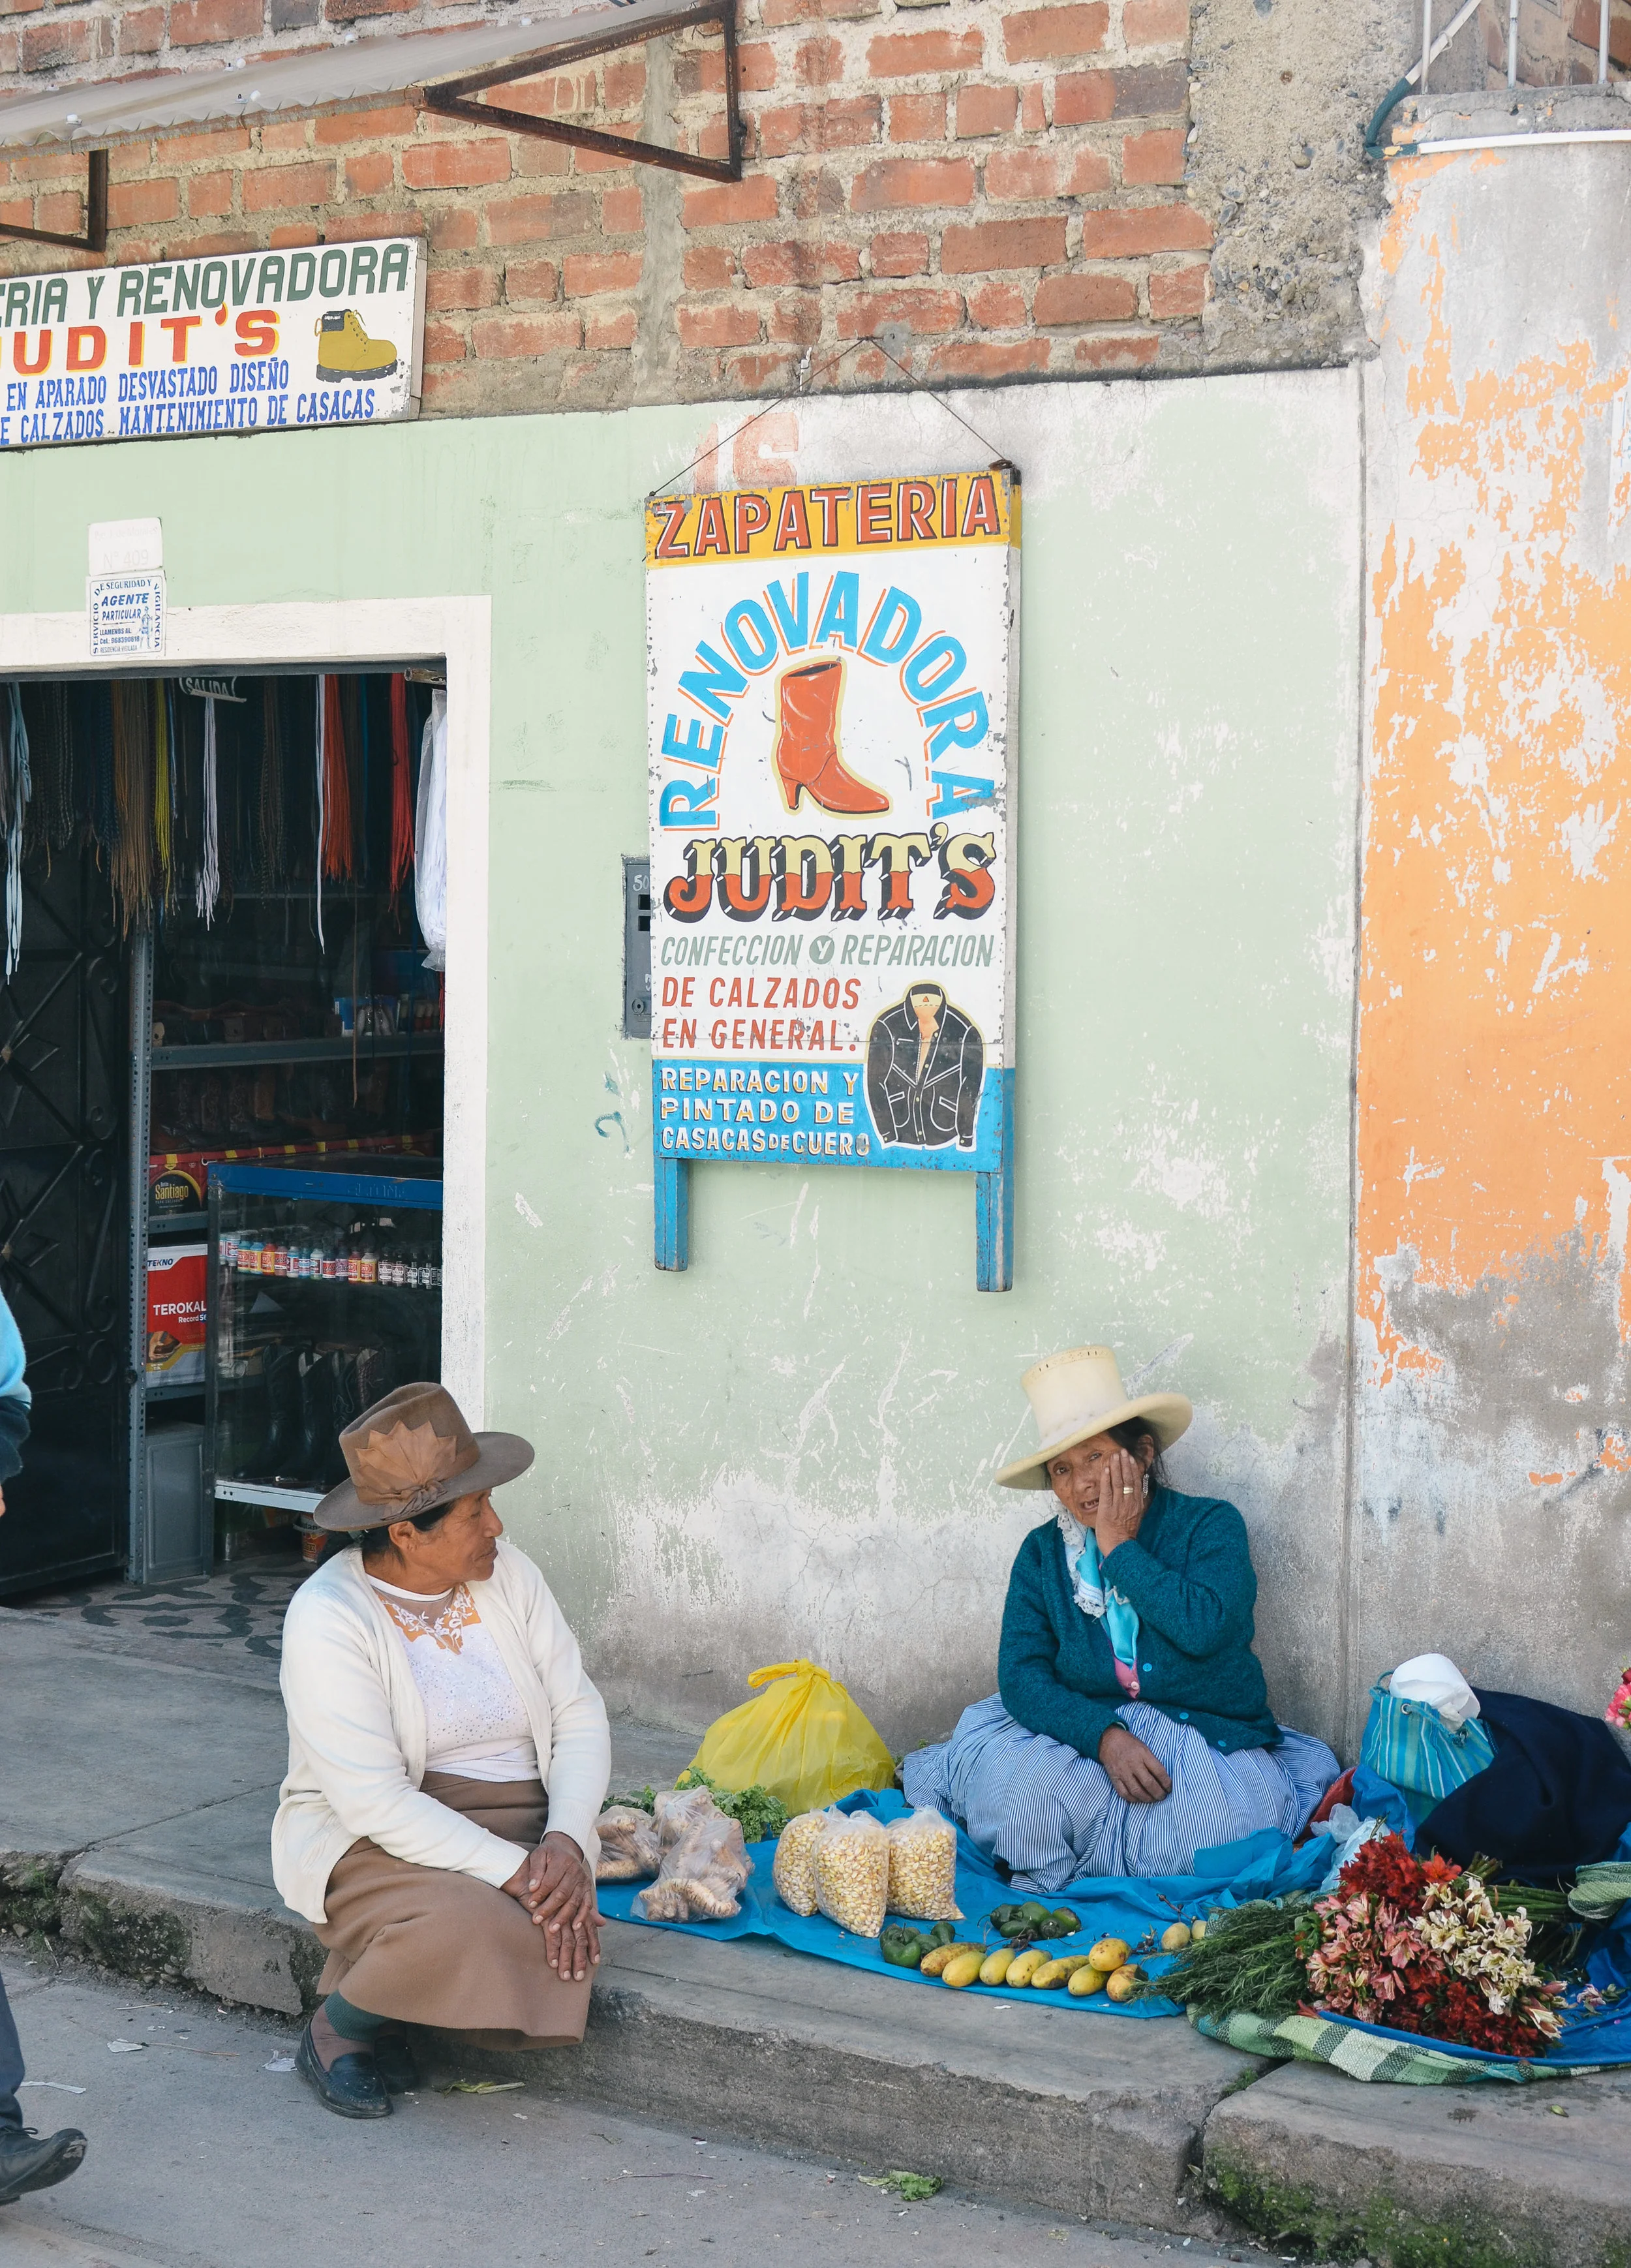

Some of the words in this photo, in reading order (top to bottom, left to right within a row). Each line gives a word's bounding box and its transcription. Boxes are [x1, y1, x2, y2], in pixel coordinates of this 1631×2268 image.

[87, 275, 104, 320] Y
[117, 243, 409, 316] RENOVADORA
[0, 303, 279, 376] UDIT'S
[7, 382, 27, 412] EN
[37, 375, 106, 410] APARADO
[118, 366, 217, 402] DESVASTADO
[230, 356, 288, 393] DISEÑO
[21, 409, 104, 444] CALZADOS
[119, 397, 257, 436] MANTENIMIENTO
[267, 394, 287, 425] DE
[296, 388, 374, 423] CASACAS
[653, 475, 1001, 560] ZAPATERIA
[123, 549, 149, 567] 409
[94, 583, 104, 596] DE
[106, 579, 145, 590] SEGURIDAD
[101, 592, 149, 607] AGENTE
[102, 608, 142, 621] PARTICULAR
[659, 572, 996, 829] RENOVADORA
[663, 821, 998, 923] JUDIT'S
[661, 934, 803, 966] CONFECCION
[815, 939, 831, 961] Y
[840, 934, 995, 967] REPARACION
[662, 977, 695, 1008] DE
[710, 977, 862, 1009] CALZADOS
[663, 1019, 697, 1050] EN
[711, 1019, 857, 1052] GENERAL.
[662, 1067, 828, 1096] REPARACION
[843, 1073, 859, 1096] Y
[661, 1097, 801, 1126] PINTADO
[814, 1101, 855, 1125] DE
[661, 1127, 767, 1153] CASACAS
[791, 1130, 870, 1156] CUERO
[155, 1184, 189, 1201] Santiago
[147, 1258, 174, 1266] TEKNO
[153, 1300, 207, 1316] TEROKAL
[178, 1314, 199, 1323] Record
